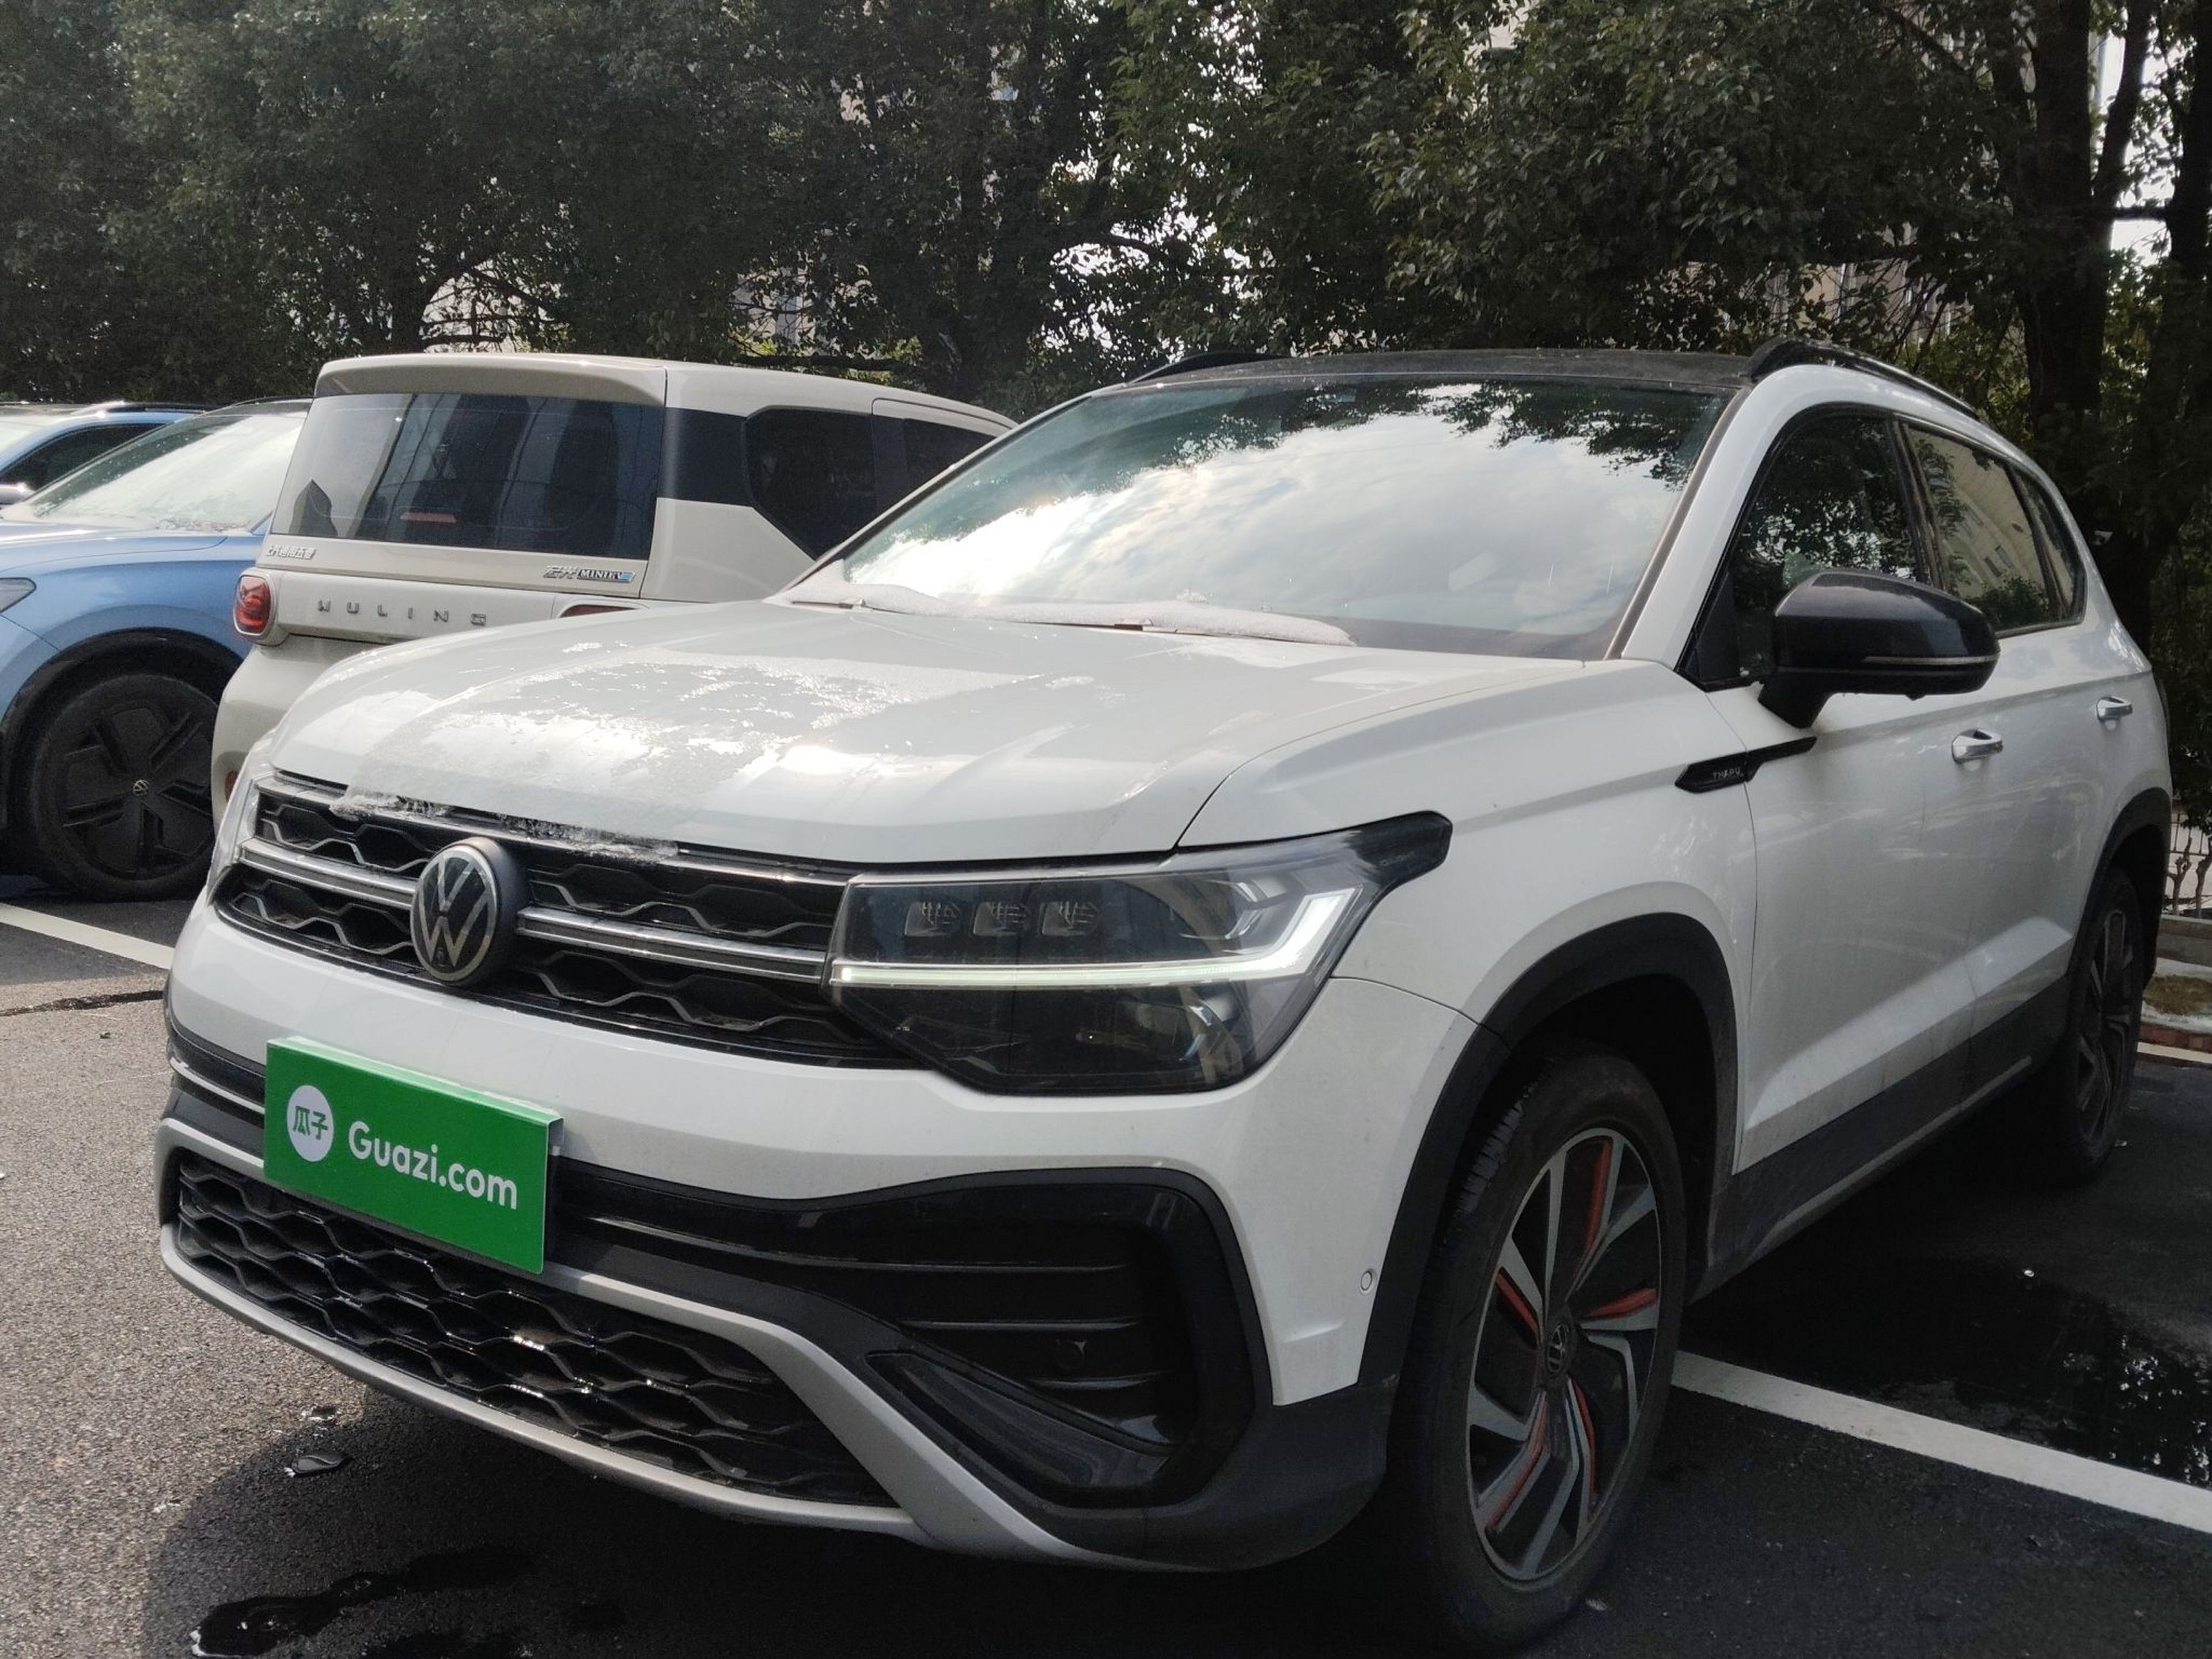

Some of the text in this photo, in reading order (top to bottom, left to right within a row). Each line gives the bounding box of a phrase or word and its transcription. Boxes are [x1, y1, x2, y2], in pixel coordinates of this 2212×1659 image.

[318, 600, 487, 626] WULING
[293, 1105, 328, 1140] 瓜子
[349, 1120, 517, 1210] Guazi.com
